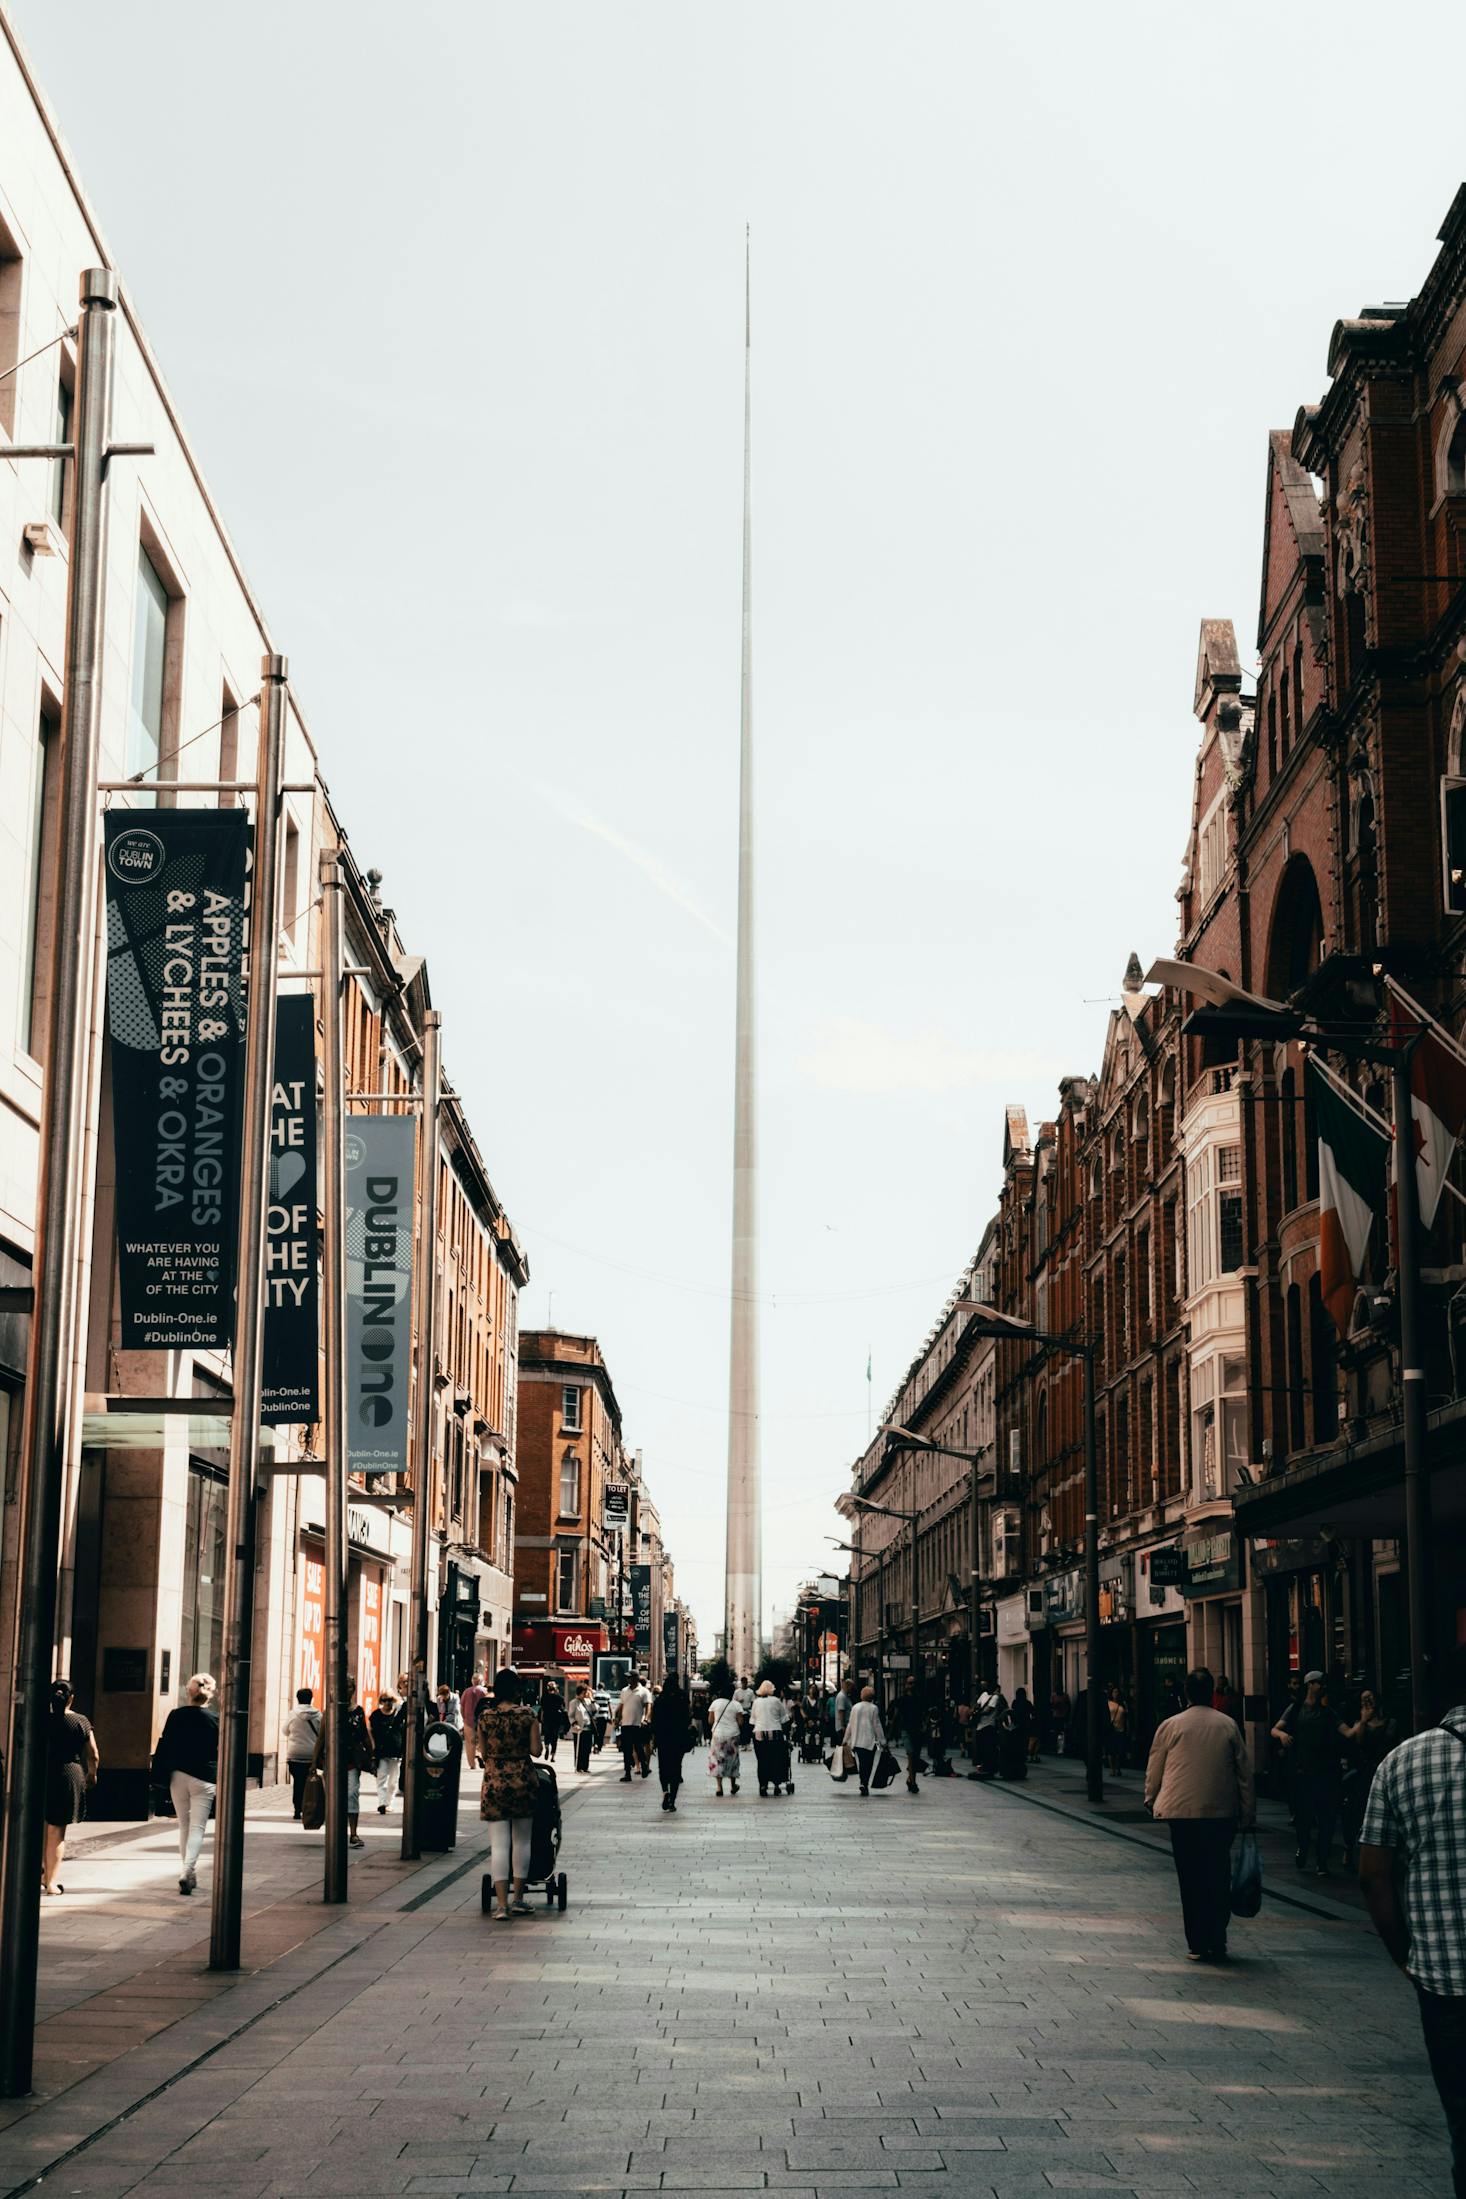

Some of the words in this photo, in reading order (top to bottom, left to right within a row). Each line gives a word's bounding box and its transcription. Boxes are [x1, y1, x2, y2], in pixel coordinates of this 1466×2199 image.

[119, 849, 153, 860] DUBLIN
[119, 857, 152, 869] TOWN
[166, 889, 196, 913] &
[200, 890, 231, 1009] APPLES
[159, 924, 194, 1067] LYCHEES
[197, 1017, 228, 1042] &
[158, 1075, 188, 1102] &
[272, 1081, 305, 1110] AT
[191, 1053, 226, 1226] ORANGES
[271, 1117, 305, 1146] HE
[153, 1111, 187, 1213] OKRA
[267, 1204, 308, 1235] OF
[126, 1243, 191, 1253] WHATEVER
[195, 1243, 220, 1253] YOU
[267, 1241, 308, 1271] HE
[147, 1257, 171, 1267] ARE
[175, 1257, 219, 1267] HAVING
[162, 1271, 177, 1281] AT
[180, 1271, 203, 1281] THE
[146, 1285, 162, 1295] OF
[165, 1285, 189, 1295] THE
[192, 1285, 219, 1295] CITY
[265, 1277, 310, 1308] ITY
[133, 1312, 218, 1324] Dublin-One.ie
[144, 1331, 217, 1343] #DublinOne
[260, 1386, 311, 1398] blin-One.ie
[260, 1401, 311, 1412] DublinOne
[634, 1623, 650, 1631] CITY
